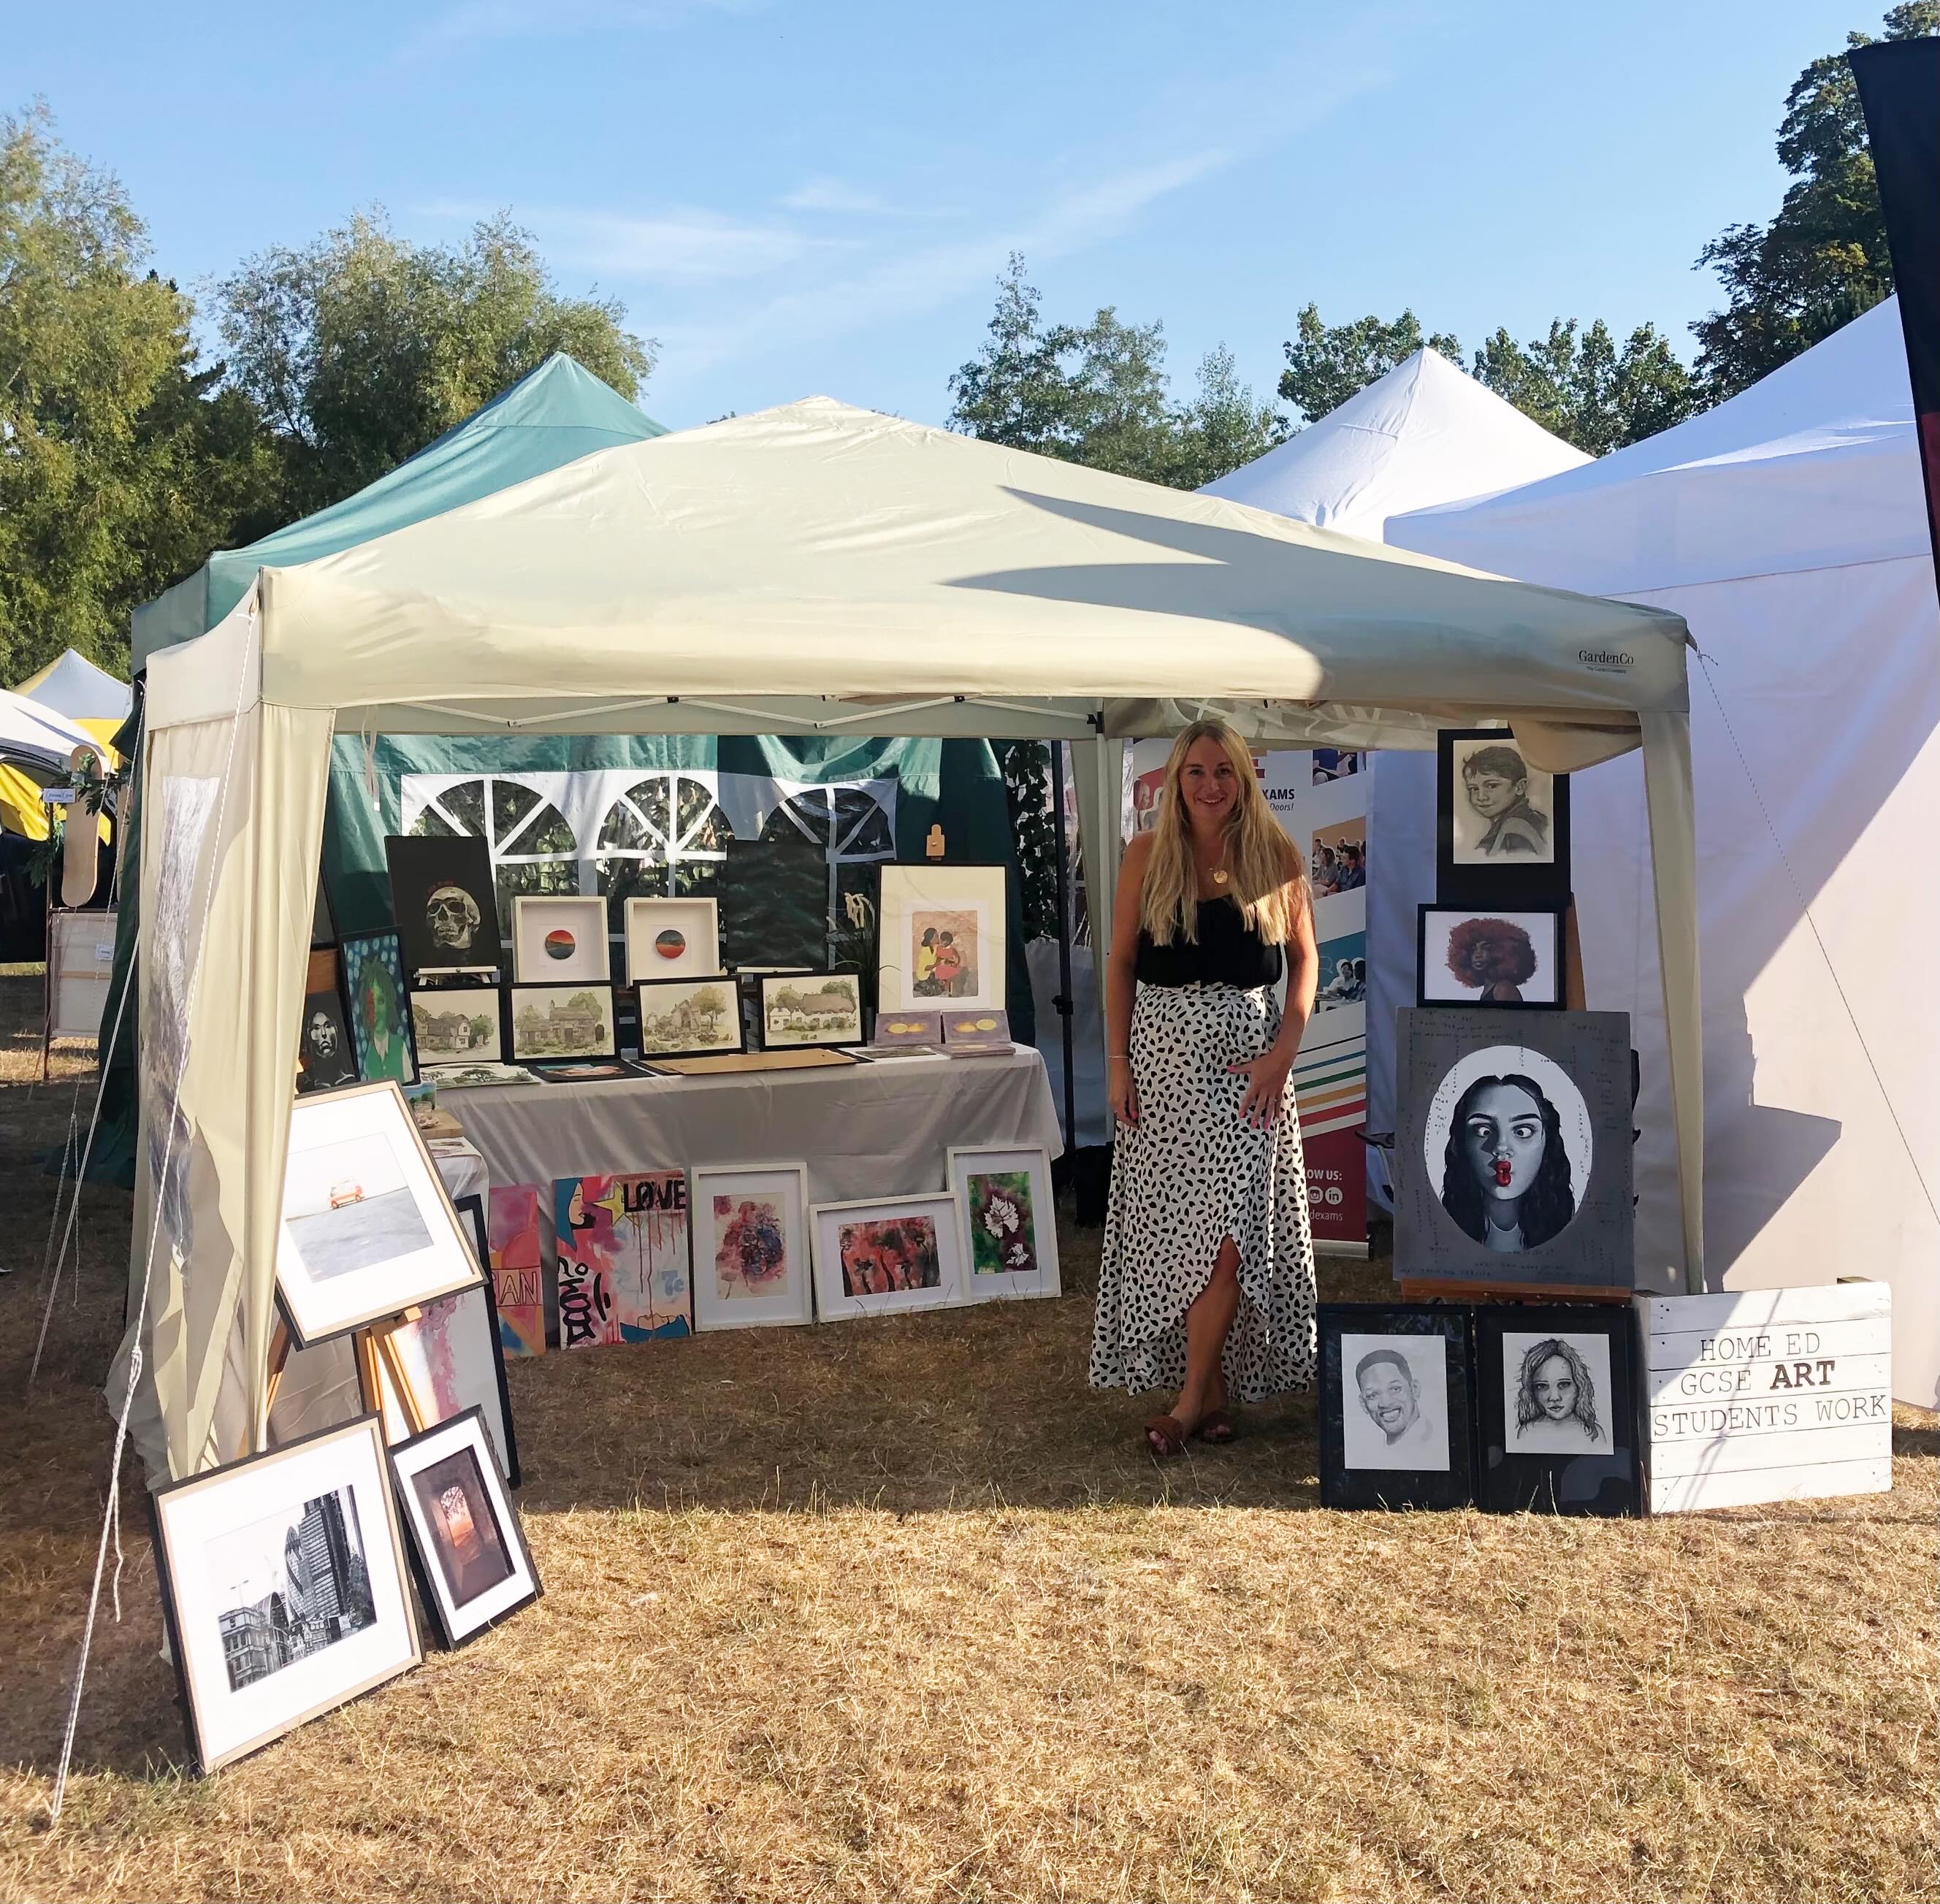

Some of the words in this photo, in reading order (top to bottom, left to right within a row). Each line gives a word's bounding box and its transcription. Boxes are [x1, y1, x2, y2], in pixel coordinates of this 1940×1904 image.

[1578, 649, 1635, 665] GardenCo
[1262, 789, 1295, 800] XAMS
[1305, 1169, 1324, 1180] OW
[1326, 1170, 1343, 1181] US:
[1310, 1209, 1343, 1221] dexams
[492, 1271, 538, 1305] AN
[1700, 1336, 1771, 1361] HOME
[1785, 1333, 1820, 1356] ED
[1681, 1370, 1752, 1396] GCSE
[1769, 1361, 1836, 1391] ART
[1654, 1404, 1798, 1437] STUDENTS
[1815, 1395, 1887, 1422] WORK
